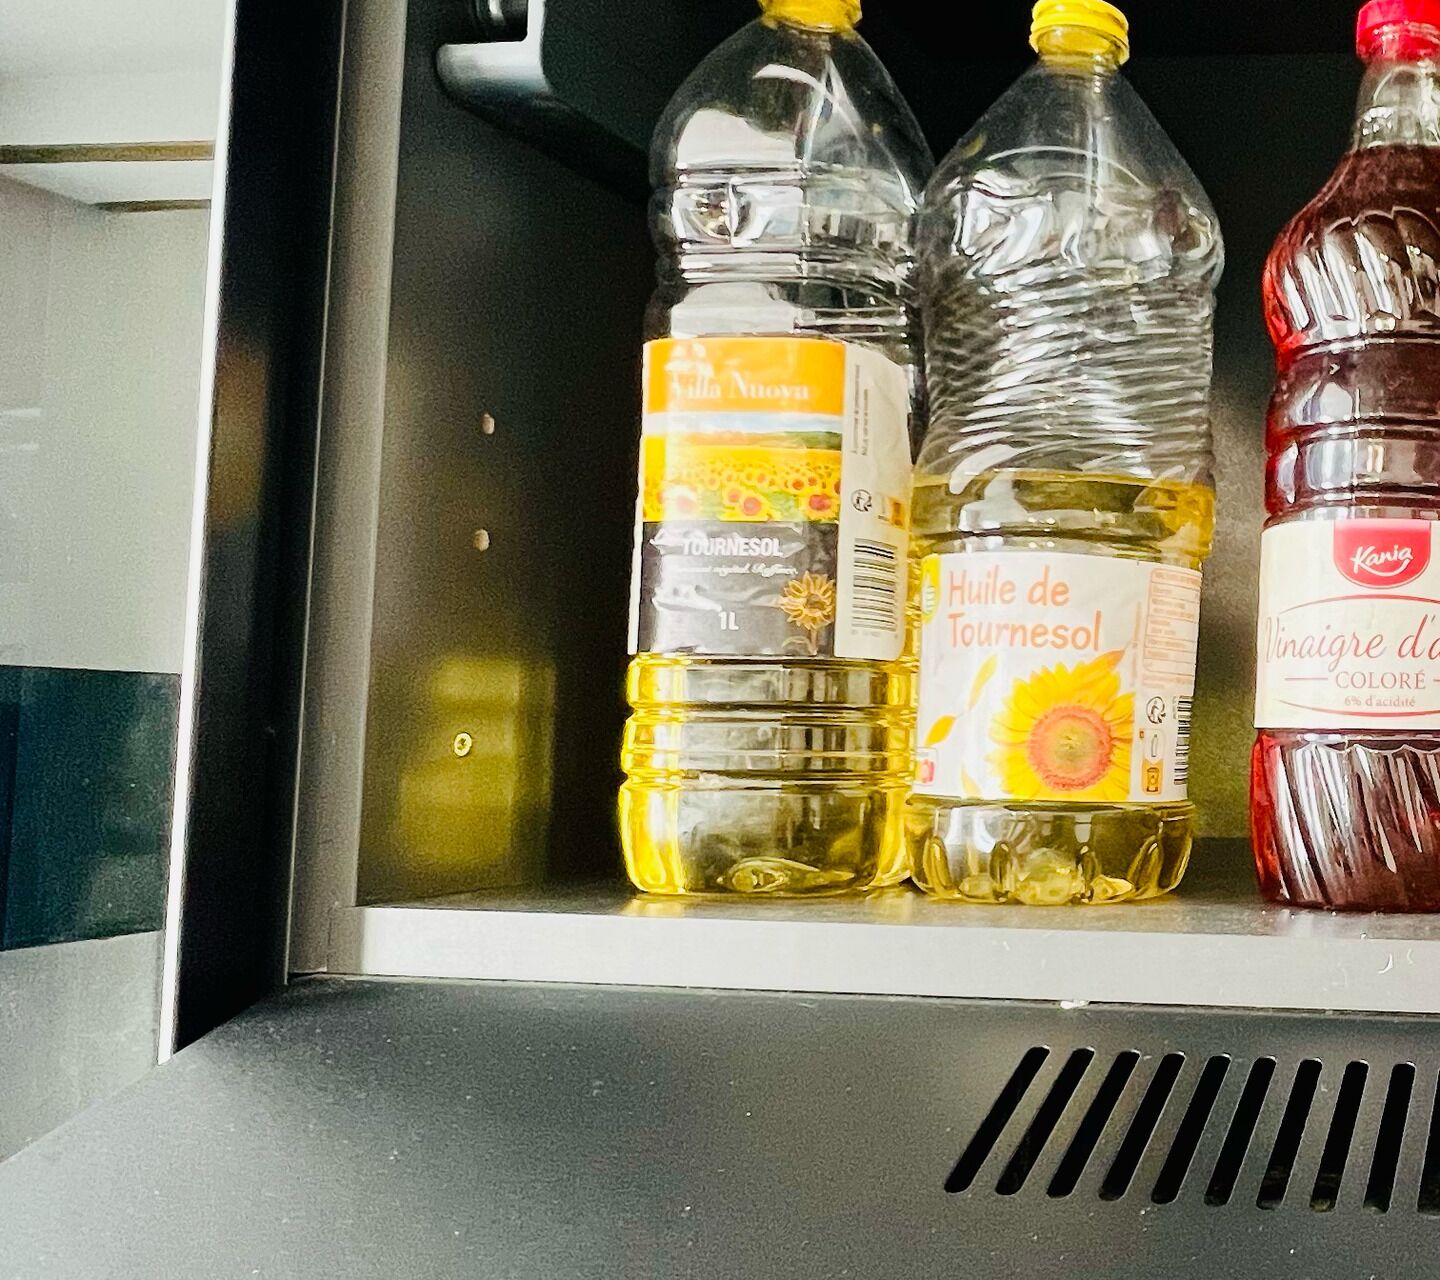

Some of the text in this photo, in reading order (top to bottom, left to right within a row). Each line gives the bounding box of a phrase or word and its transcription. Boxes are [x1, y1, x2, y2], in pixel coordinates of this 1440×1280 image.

[682, 537, 784, 557] TOURNESOL
[1350, 544, 1413, 575] Kania
[947, 565, 1016, 606] Huile
[1027, 565, 1070, 606] de
[717, 611, 740, 631] 1L
[947, 609, 1102, 651] Tournesol
[1265, 616, 1386, 672] Vinaigre
[1335, 670, 1426, 691] COLORÉ
[1344, 695, 1416, 708] 6% d'acidité
